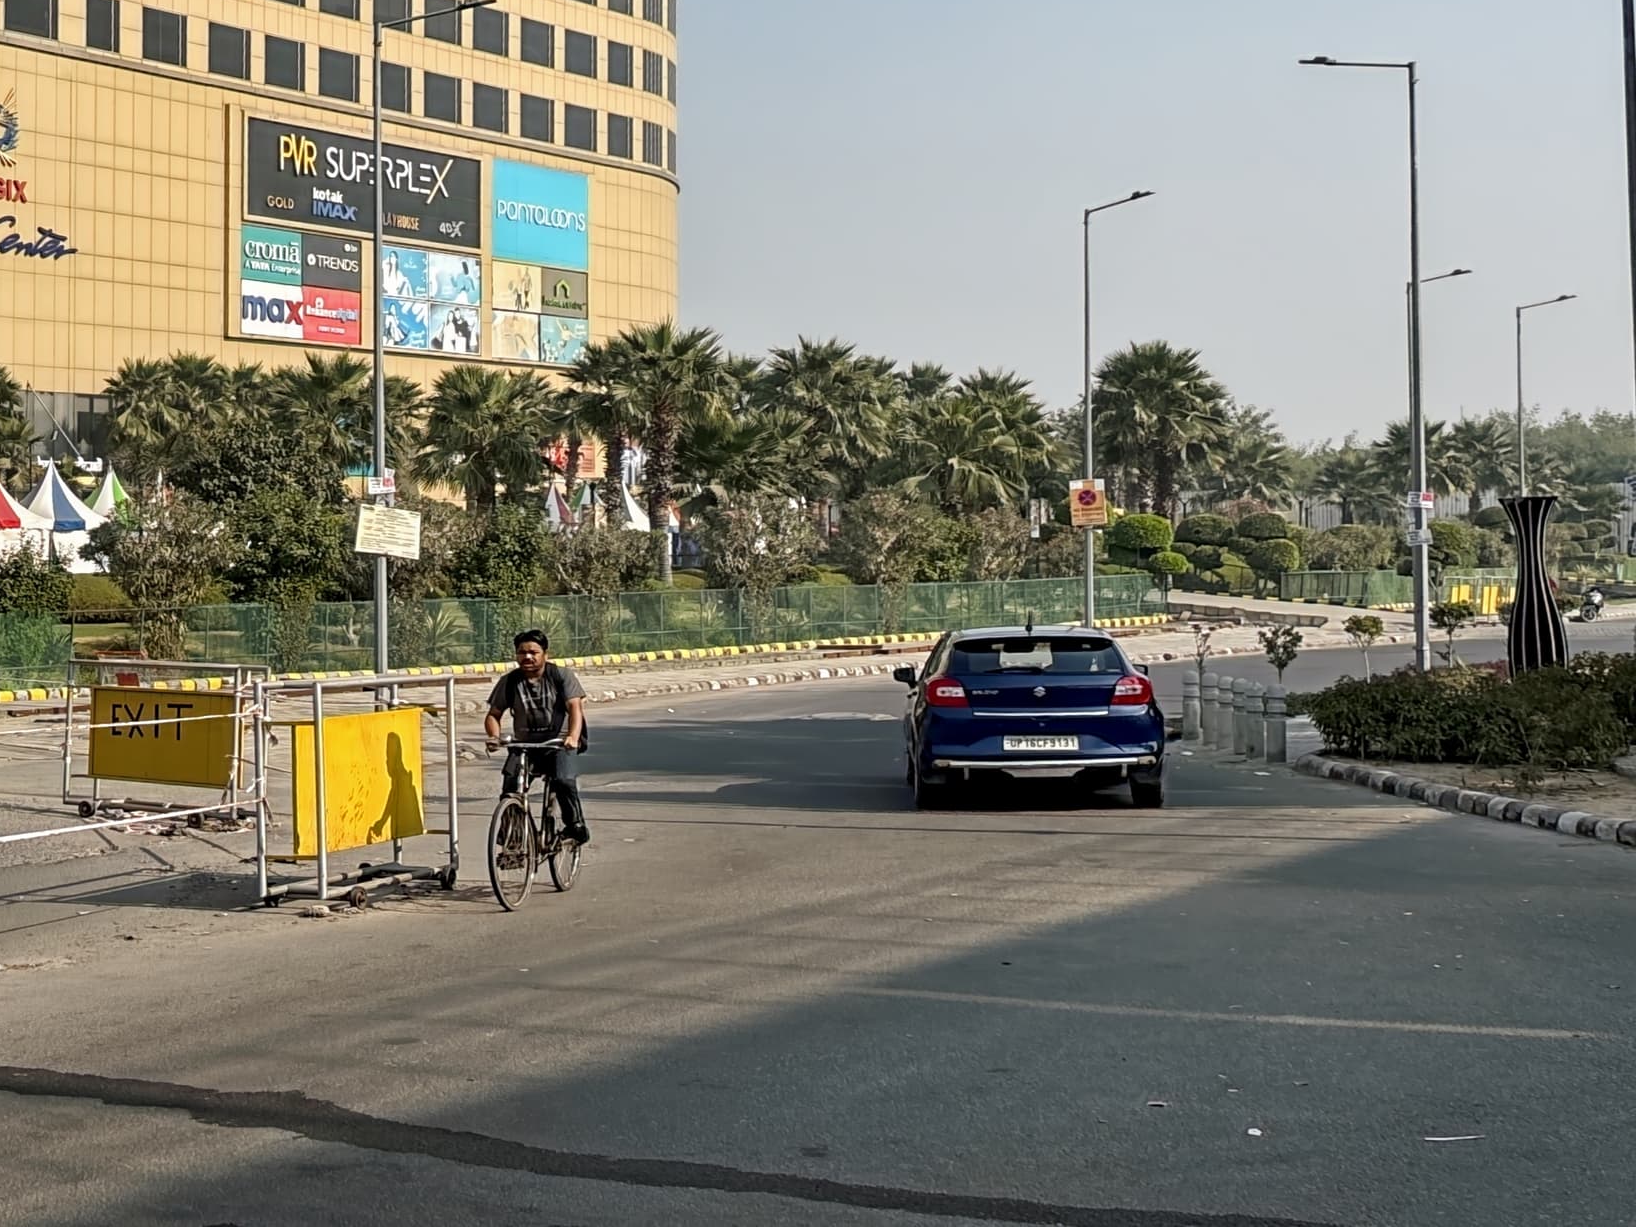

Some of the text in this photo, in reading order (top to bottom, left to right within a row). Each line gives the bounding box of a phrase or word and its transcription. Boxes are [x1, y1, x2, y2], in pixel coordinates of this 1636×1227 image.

[280, 133, 454, 204] PVR SUPERPLEX
[267, 195, 294, 210] GOLD
[313, 187, 343, 204] kotak
[313, 201, 357, 221] IMAX
[382, 212, 420, 231] LAYHOUSE
[251, 261, 270, 270] TATA
[316, 254, 359, 272] TRENDS
[242, 294, 303, 325] max
[111, 702, 193, 741] EXIT
